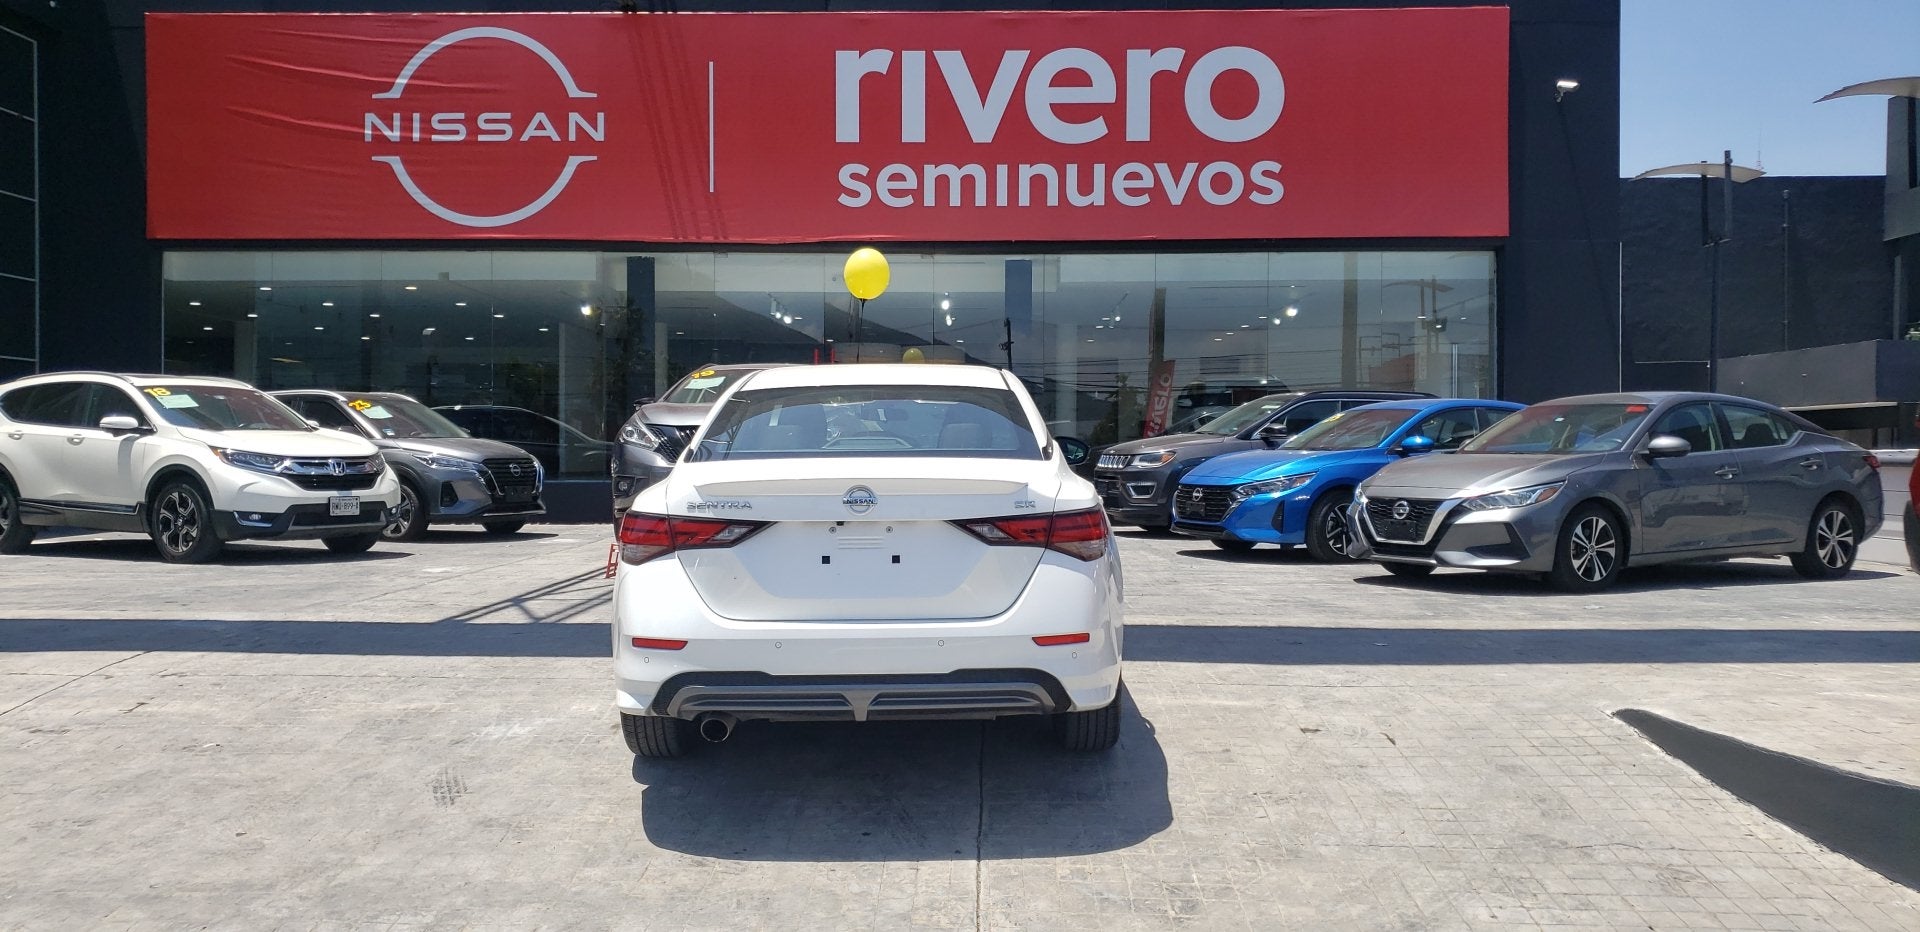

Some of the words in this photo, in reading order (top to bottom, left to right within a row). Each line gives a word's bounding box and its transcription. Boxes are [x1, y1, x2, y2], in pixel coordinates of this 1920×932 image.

[835, 46, 1286, 144] rivero
[364, 112, 605, 142] NISSAN
[837, 160, 1285, 207] seminuevos
[143, 387, 171, 397] 18
[686, 501, 752, 510] SENTRA
